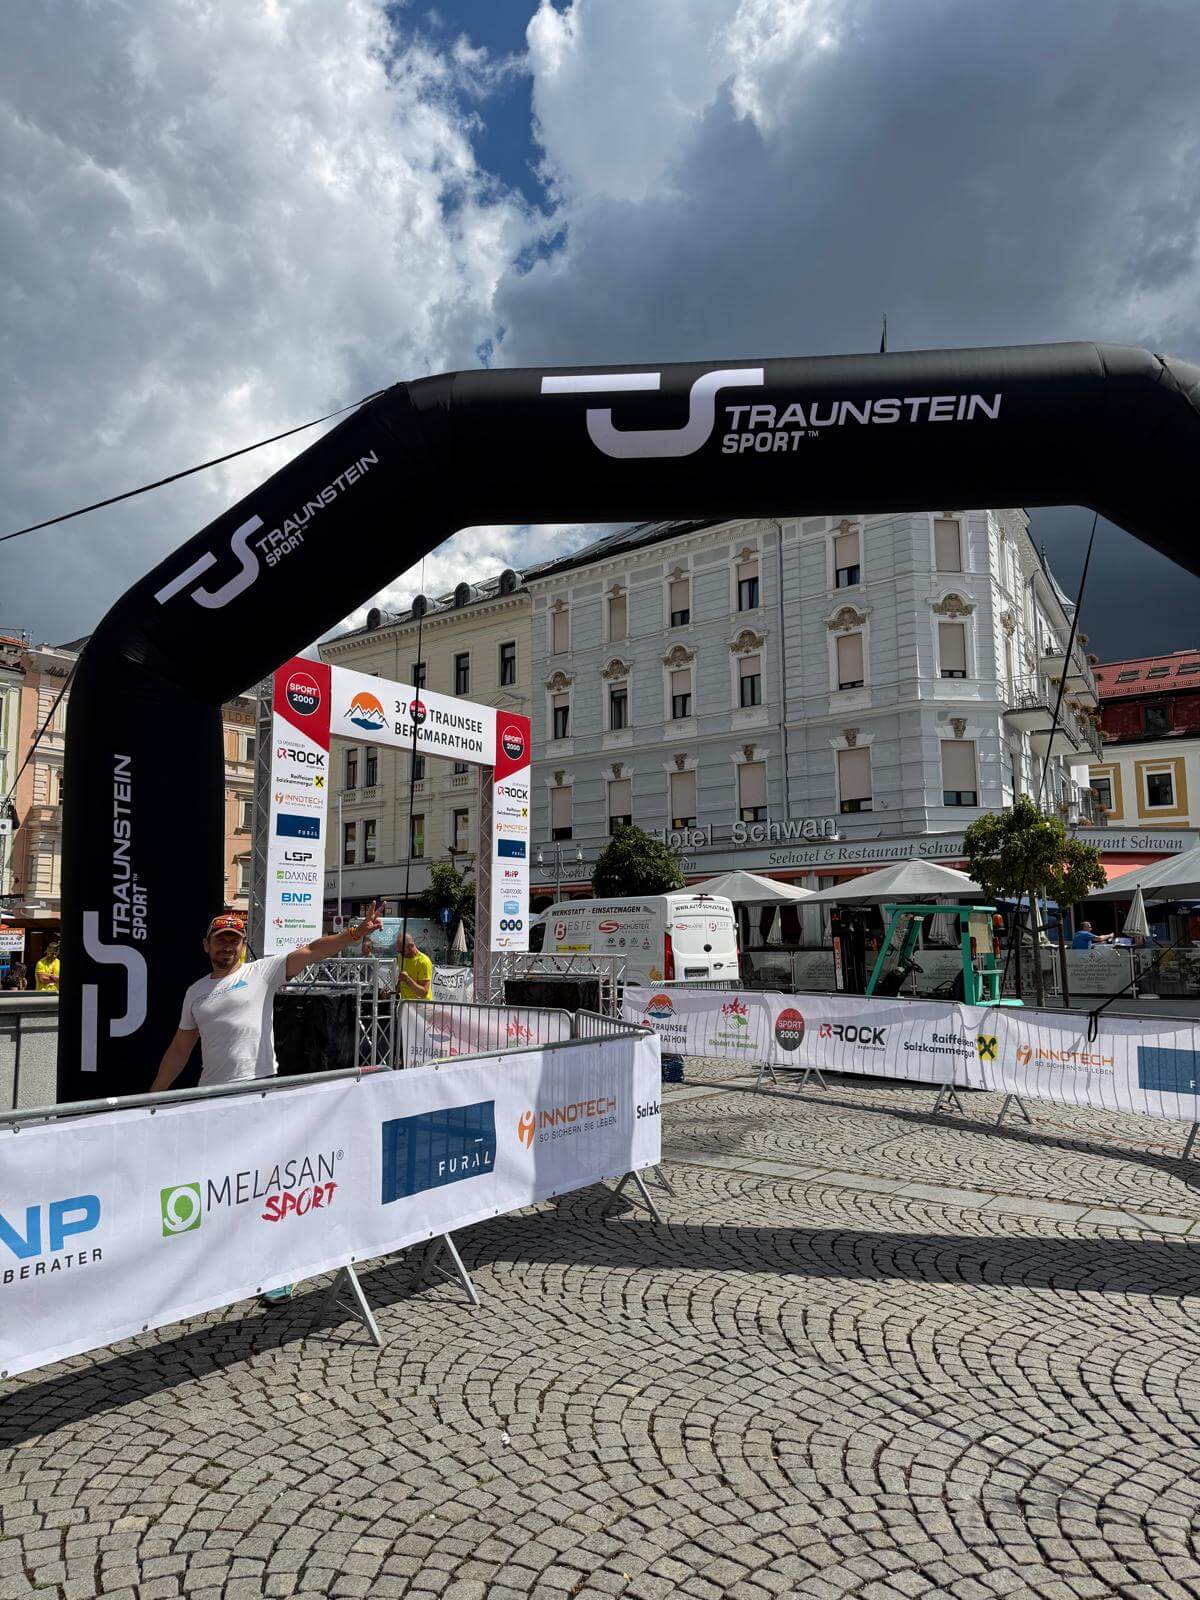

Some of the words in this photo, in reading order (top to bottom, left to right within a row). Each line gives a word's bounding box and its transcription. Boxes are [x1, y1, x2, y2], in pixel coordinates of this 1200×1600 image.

[724, 393, 1003, 431] TRAUNSTEIN
[255, 449, 379, 554] TRAUNSTEIN
[289, 682, 318, 695] SPORT
[292, 693, 314, 705] 2000
[394, 700, 407, 715] 37
[429, 709, 483, 734] TRAUNSEE
[504, 734, 522, 743] SPORT
[506, 743, 521, 752] 2000
[285, 793, 324, 805] INNOTECH
[652, 823, 713, 849] Hotel
[731, 816, 838, 845] Schwan
[112, 753, 132, 939] TRAUNSTEIN
[1130, 835, 1183, 849] Schwan
[284, 851, 313, 862] LSP
[768, 848, 819, 865] Seehotel
[823, 847, 834, 861] &
[839, 843, 914, 861] Restaurant
[918, 840, 963, 855] Schwa
[285, 870, 318, 882] DAXNER
[281, 892, 312, 903] BNP
[551, 907, 586, 917] WERKSTATT
[592, 906, 641, 914] EINSATZWAGEN
[651, 1022, 688, 1033] TRAUNSEE
[778, 1019, 803, 1029] SPORT
[780, 1029, 800, 1039] 2000
[903, 1041, 975, 1059] Salzkammergut
[1035, 1047, 1114, 1067] INNOTECH
[1046, 1061, 1077, 1071] SICHERN
[1092, 1068, 1115, 1076] LEBEN
[538, 1095, 617, 1129] INNOTECH
[636, 1100, 661, 1120] Salzk
[539, 1132, 550, 1143] SO
[551, 1125, 582, 1140] SICHERN
[583, 1120, 595, 1131] SIE
[596, 1115, 617, 1128] LEBEN
[438, 1148, 492, 1177] FURAL
[261, 1182, 338, 1222] SPORT
